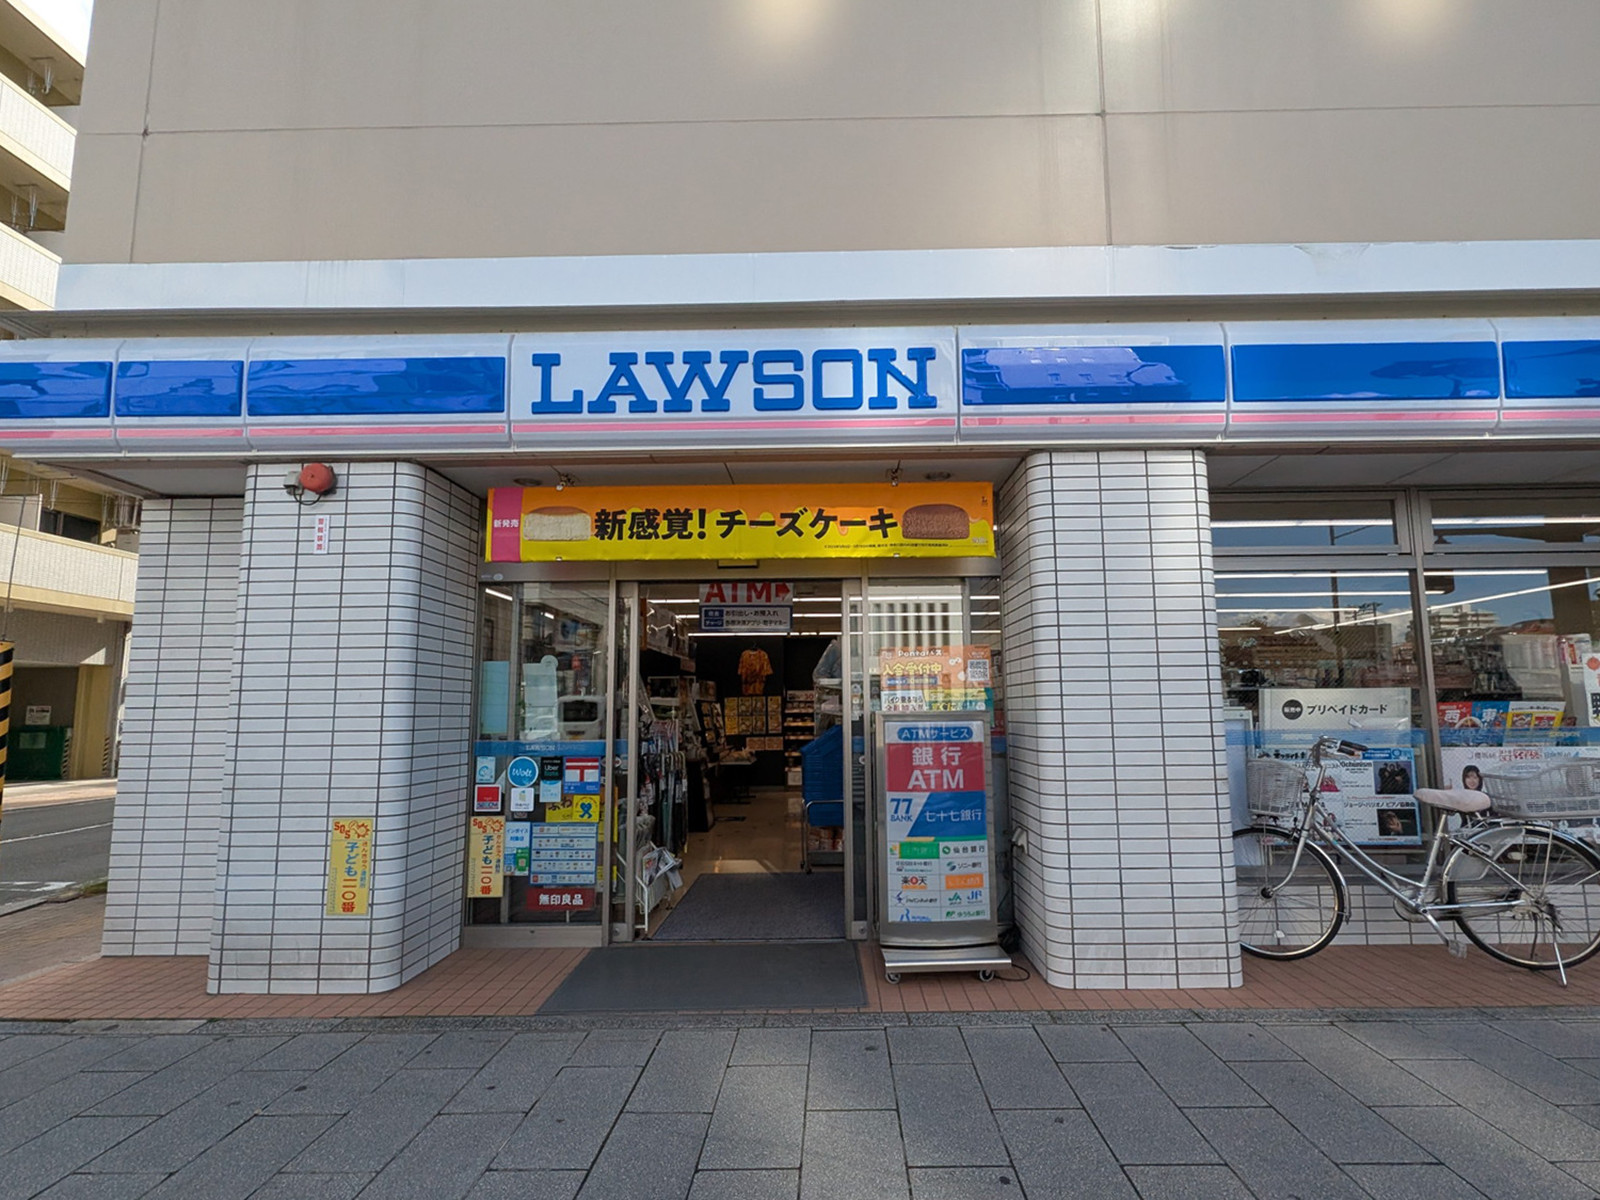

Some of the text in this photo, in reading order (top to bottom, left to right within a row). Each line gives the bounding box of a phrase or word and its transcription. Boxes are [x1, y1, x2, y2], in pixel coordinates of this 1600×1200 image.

[531, 347, 937, 414] LAWSON
[494, 519, 519, 528] 新発売
[1307, 704, 1388, 716] プリペイドカード
[1444, 709, 1460, 723] 西
[901, 728, 970, 739] ATMサービス
[912, 747, 962, 766] 銀行
[512, 768, 532, 778] Wolt
[907, 769, 964, 789] ATM
[890, 798, 913, 815] 77
[924, 809, 983, 822] 七十七銀行
[334, 821, 351, 839] SOS
[539, 894, 584, 906] 無印良品
